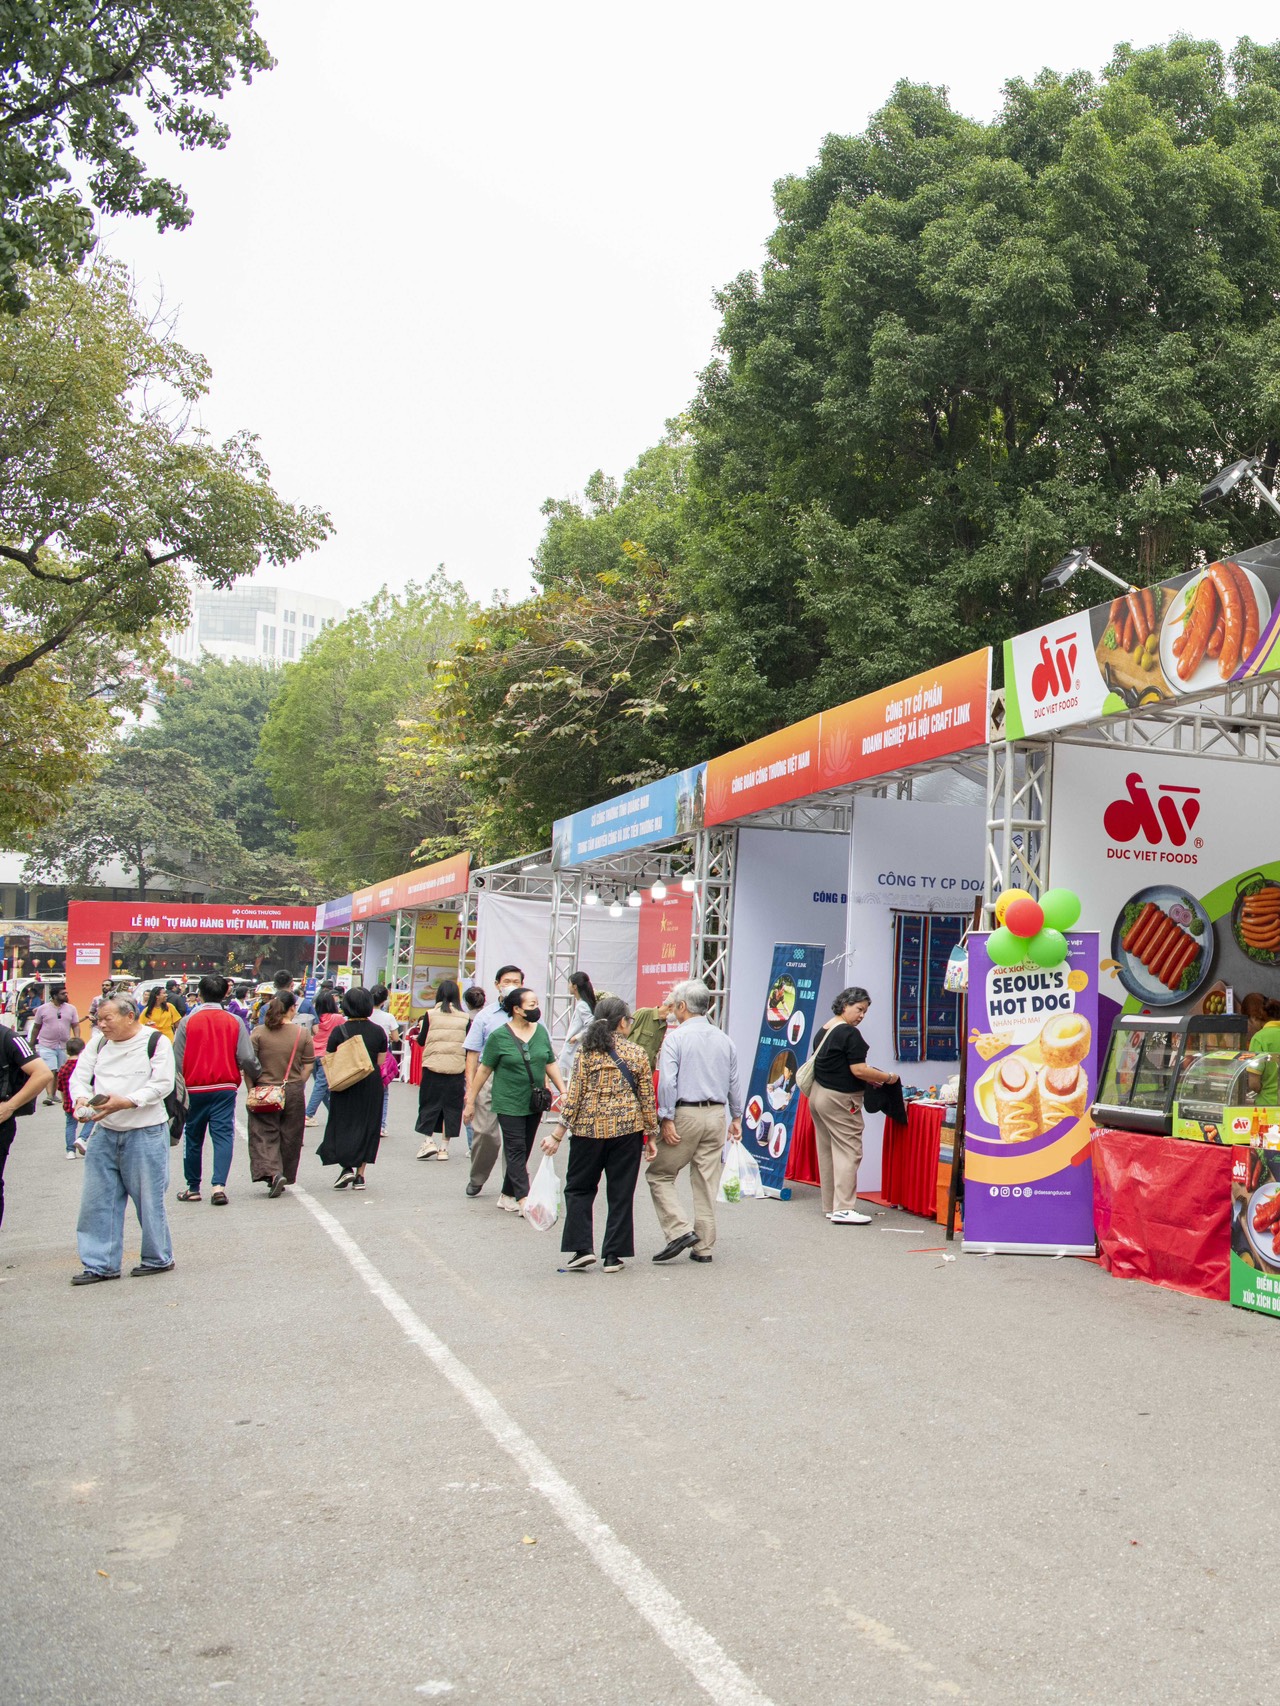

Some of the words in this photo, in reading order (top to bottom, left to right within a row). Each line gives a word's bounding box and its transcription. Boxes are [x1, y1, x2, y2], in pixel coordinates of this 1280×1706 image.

[886, 699, 902, 723] CÔNG
[904, 697, 912, 717] TY
[1034, 707, 1046, 719] DUC
[1047, 703, 1058, 715] VIET
[1059, 697, 1078, 712] FOODS
[862, 732, 883, 756] DOANH
[883, 721, 906, 748] NGHIỆP
[908, 717, 917, 741] XÃ
[918, 713, 930, 741] HỘI
[931, 708, 953, 733] CRAFT
[954, 702, 971, 727] LINK
[1107, 848, 1131, 860] DUC
[1133, 849, 1157, 862] VIET
[1160, 851, 1198, 865] FOODS
[878, 871, 916, 888] CÔNG
[921, 876, 937, 889] TY
[940, 877, 957, 890] CP
[813, 890, 838, 904] CÔNG
[144, 915, 160, 928] HỘI
[179, 915, 198, 928] HÀO
[199, 915, 224, 929] HÀNG
[226, 918, 244, 931] VIỆT
[271, 919, 290, 930] TINH
[292, 920, 310, 930] HOA
[989, 997, 1027, 1017] HOT
[1032, 993, 1071, 1013] DOG
[992, 1018, 1013, 1028] NHÂN
[1256, 1274, 1272, 1292] ĐIỂM
[1242, 1287, 1255, 1304] XÚC
[1255, 1290, 1271, 1308] XÍCH
